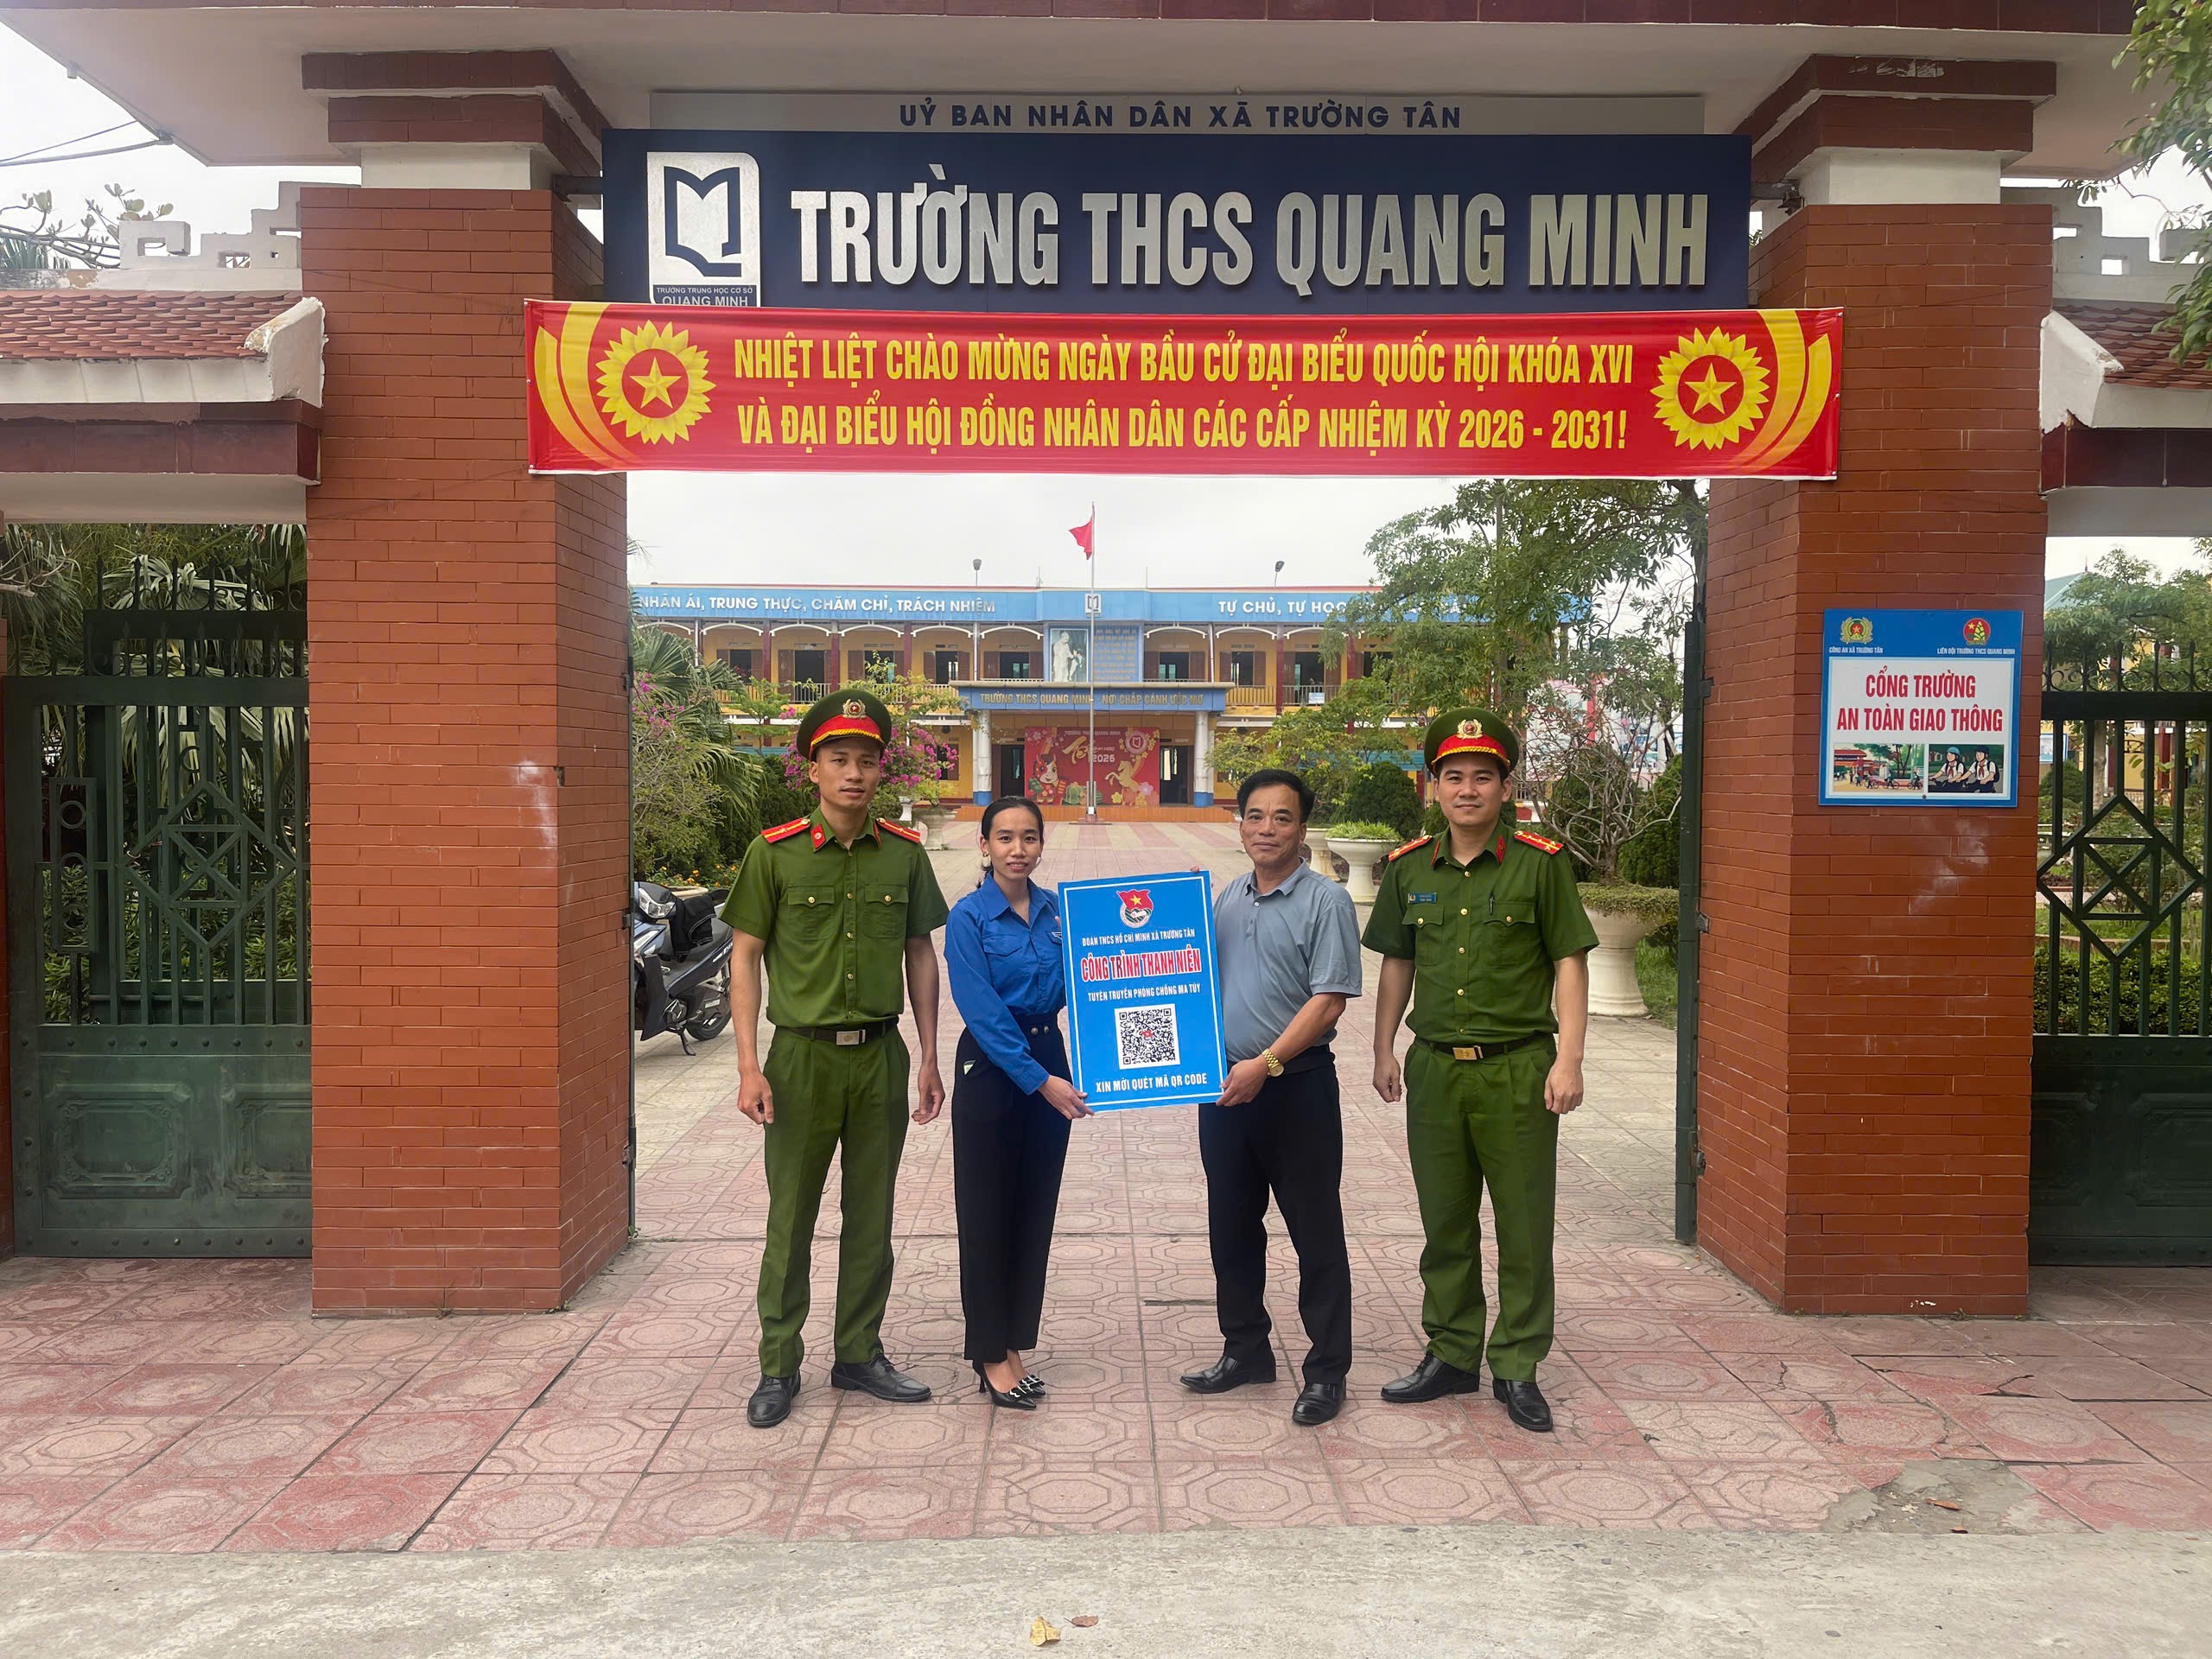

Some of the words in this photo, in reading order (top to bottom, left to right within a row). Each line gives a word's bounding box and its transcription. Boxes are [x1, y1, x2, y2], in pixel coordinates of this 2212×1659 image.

[900, 96, 937, 126] UỶ
[951, 105, 1011, 126] BAN
[1028, 99, 1113, 127] NHÂN
[1129, 99, 1191, 128] DÂN
[1209, 101, 1252, 128] XÃ
[1266, 99, 1389, 128] TRƯỜNG
[1402, 100, 1460, 129] TÂN
[791, 162, 1059, 286] TRƯỜNG
[1082, 191, 1254, 287] THCS
[1275, 191, 1505, 296] QUANG
[1528, 194, 1708, 288] MINH
[742, 285, 753, 294] SỞ
[662, 296, 711, 306] QUANG
[715, 296, 748, 307] MINH
[734, 331, 814, 388] NHIỆT
[823, 331, 878, 388] LIỆT
[886, 332, 959, 380] CHÀO
[968, 333, 1050, 381] MỪNG
[1058, 334, 1132, 382] NGÀY
[1140, 329, 1195, 382] BẦU
[1204, 329, 1243, 382] CỬ
[1248, 342, 1294, 391] ĐẠI
[1302, 327, 1363, 383] BIỂU
[1372, 329, 1446, 386] QUỐC
[1453, 335, 1499, 391] HỘI
[1508, 336, 1581, 384] KHÓA
[1588, 344, 1633, 384] XVI
[737, 396, 773, 445] VÀ
[780, 404, 827, 454] ĐẠI
[836, 389, 898, 446] BIỂU
[906, 397, 951, 454] HỘI
[960, 392, 1034, 447] ĐỒNG
[1044, 398, 1120, 448] NHÂN
[1128, 398, 1185, 448] DÂN
[1193, 399, 1247, 448] CÁC
[1256, 393, 1311, 448] CẤP
[1319, 399, 1408, 457] NHIỆM
[1416, 400, 1452, 448] KỲ
[1459, 409, 1524, 448] 2026
[1532, 427, 1543, 436] -
[1551, 410, 1627, 449] 2031!
[639, 593, 681, 608] NHÂN
[685, 594, 705, 611] ÁI,
[709, 596, 759, 609] TRUNG
[763, 596, 807, 613] THỰC,
[810, 595, 857, 611] CHĂM
[861, 594, 893, 613] CHỈ,
[896, 597, 945, 612] TRÁCH
[950, 597, 995, 615] NHIỆM
[1218, 599, 1238, 616] TỰ
[1243, 596, 1282, 616] CHỦ,
[1287, 600, 1306, 617] TỰ
[1866, 665, 1909, 698] CỔNG
[1913, 670, 1976, 698] TRƯỜNG
[980, 691, 1014, 703] TRƯỜNG
[1016, 694, 1038, 704] THCS
[1039, 694, 1069, 704] QUANG
[1102, 694, 1117, 705] NƠI
[1144, 693, 1168, 705] CÁNH
[1170, 692, 1187, 705] ƯỚC
[1189, 694, 1204, 705] MƠ
[1836, 708, 1859, 730] AN
[1863, 702, 1904, 731] TOÀN
[1909, 708, 1946, 731] GIAO
[1950, 703, 2003, 732] THÔNG
[1093, 754, 1116, 763] 2026
[1098, 935, 1115, 945] TNCS
[1135, 932, 1150, 942] MINH
[1080, 952, 1110, 982] CÔNG
[1109, 950, 1141, 980] TRÌNH
[1141, 950, 1176, 977] THANH
[1175, 944, 1202, 975] NIÊN
[1088, 989, 1108, 1002] TUYÊN
[1178, 984, 1188, 995] MA
[1096, 1081, 1111, 1093] XIN
[1113, 1077, 1130, 1091] MỜI
[1131, 1076, 1154, 1090] QUÉT
[1155, 1074, 1169, 1088] MÃ
[1171, 1075, 1183, 1087] QR
[1184, 1072, 1208, 1085] CODE
